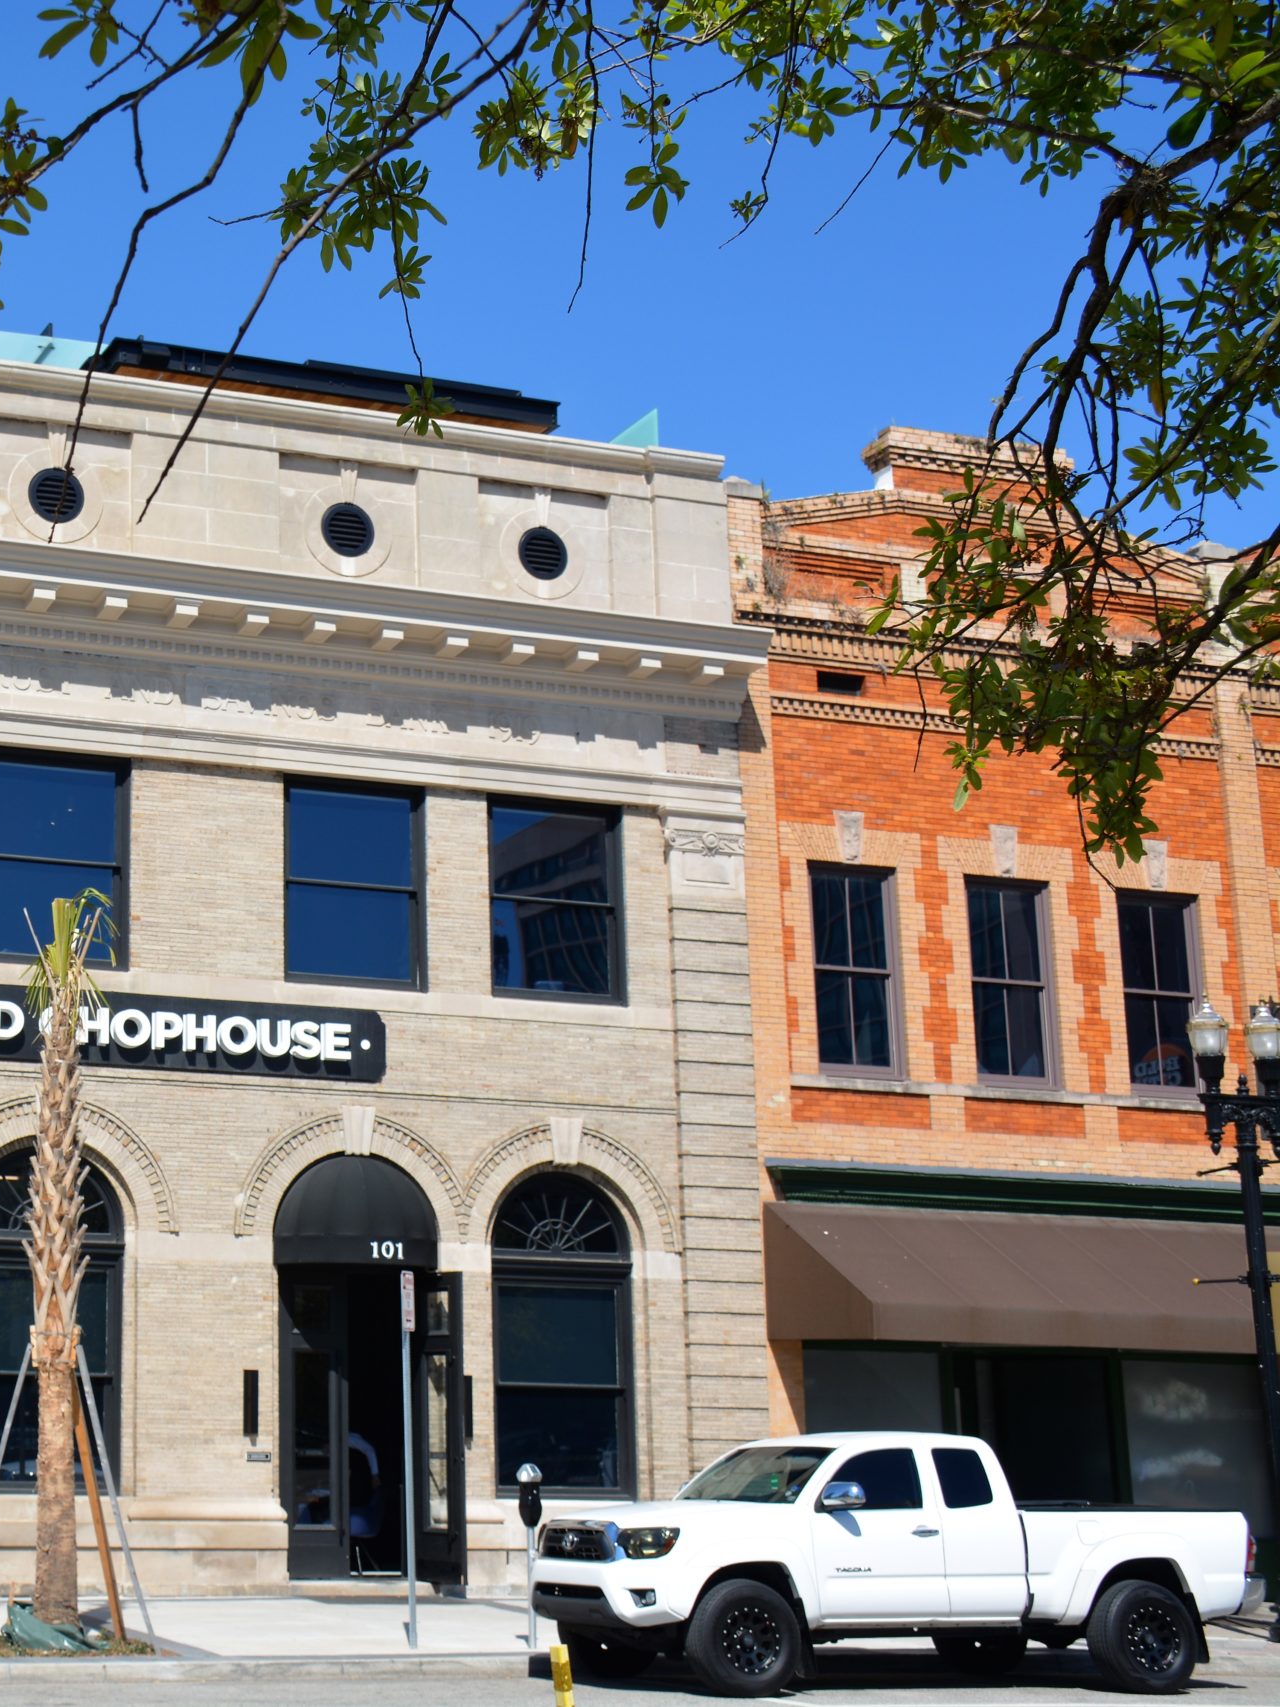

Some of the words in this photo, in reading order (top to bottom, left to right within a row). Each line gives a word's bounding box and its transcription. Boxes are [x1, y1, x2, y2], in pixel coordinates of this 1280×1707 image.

[104, 672, 176, 705] AND
[365, 695, 451, 734] BANK
[370, 1241, 405, 1260] 101
